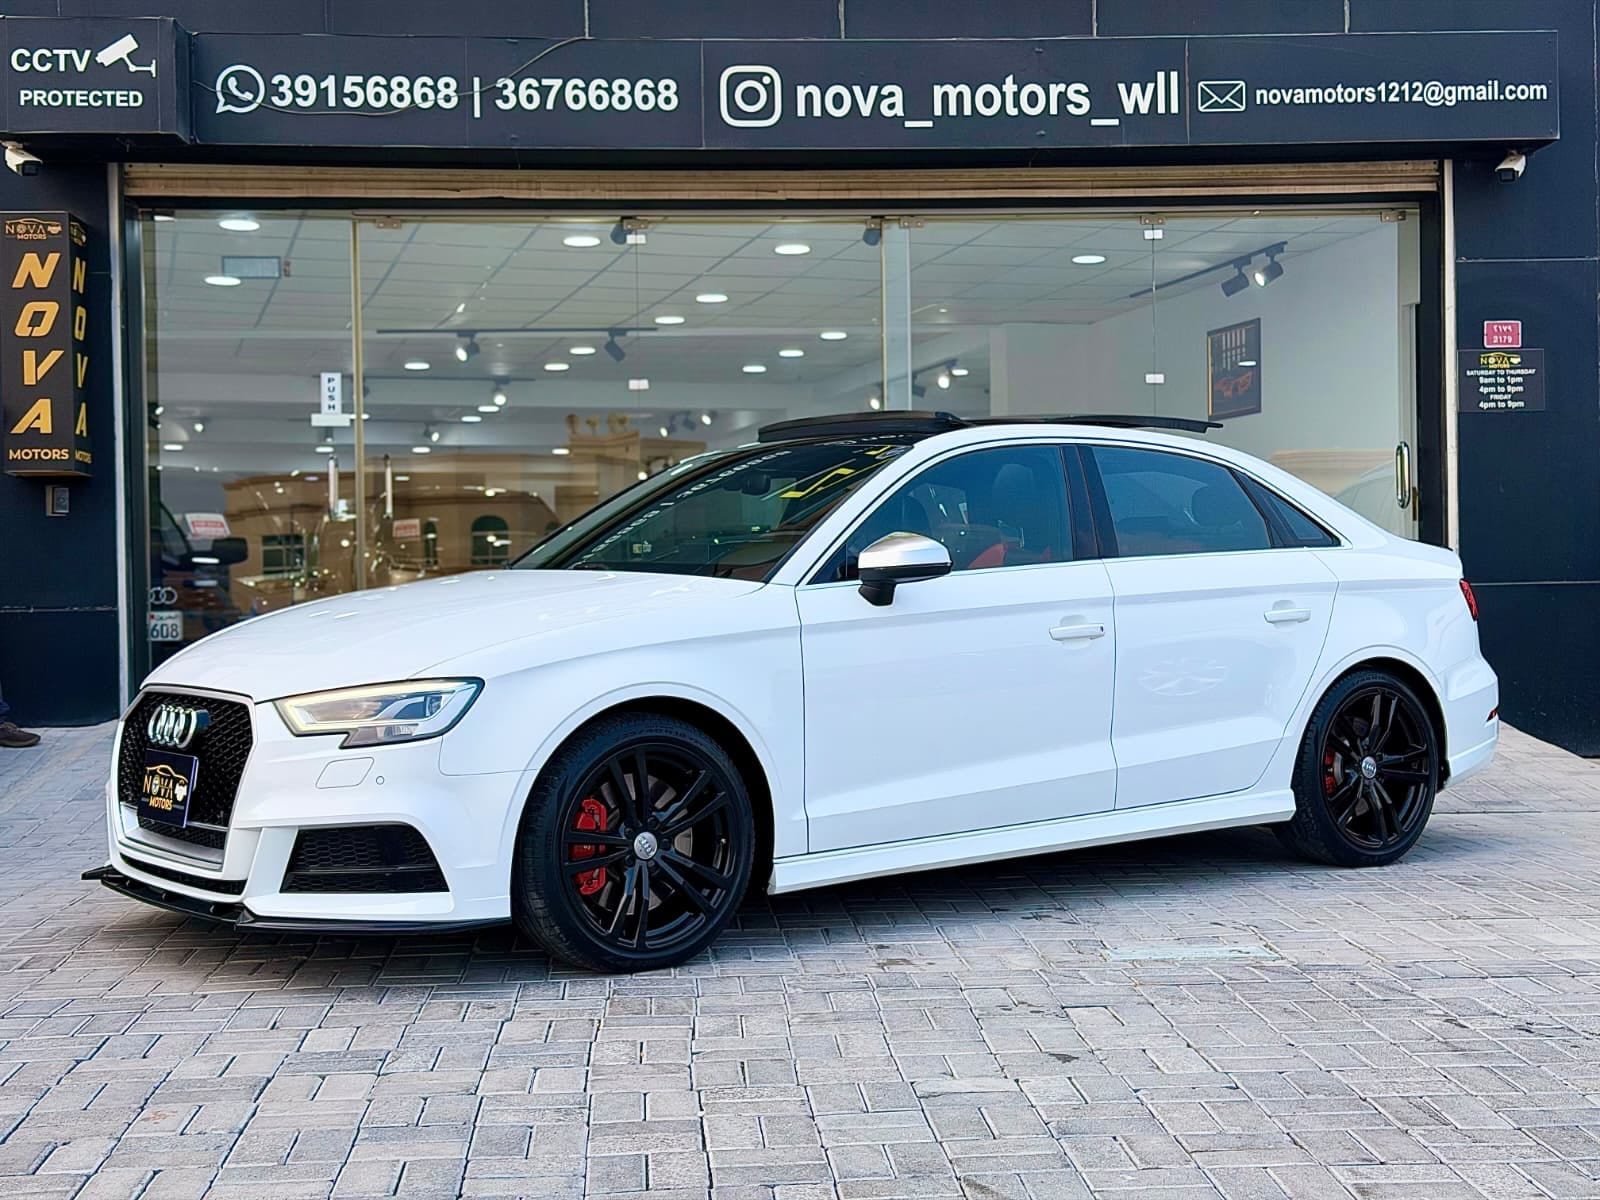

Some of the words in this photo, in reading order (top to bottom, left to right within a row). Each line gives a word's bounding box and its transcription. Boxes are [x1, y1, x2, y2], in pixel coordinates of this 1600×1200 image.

[11, 48, 91, 72] CCTV
[19, 89, 143, 107] PROTECTED
[271, 74, 458, 109] 39156868
[495, 77, 679, 111] 36766868
[796, 71, 1180, 128] nova_motors_wll
[1255, 80, 1548, 107] novamotors1212@gmail.com
[1478, 385, 1496, 394] 4pm
[1507, 376, 1524, 384] 1pm
[327, 376, 336, 411] PUSH
[1478, 401, 1496, 410] 4pm
[8, 448, 70, 460] MOTORS
[142, 774, 174, 799] NOVA
[149, 797, 173, 811] MOTORS
